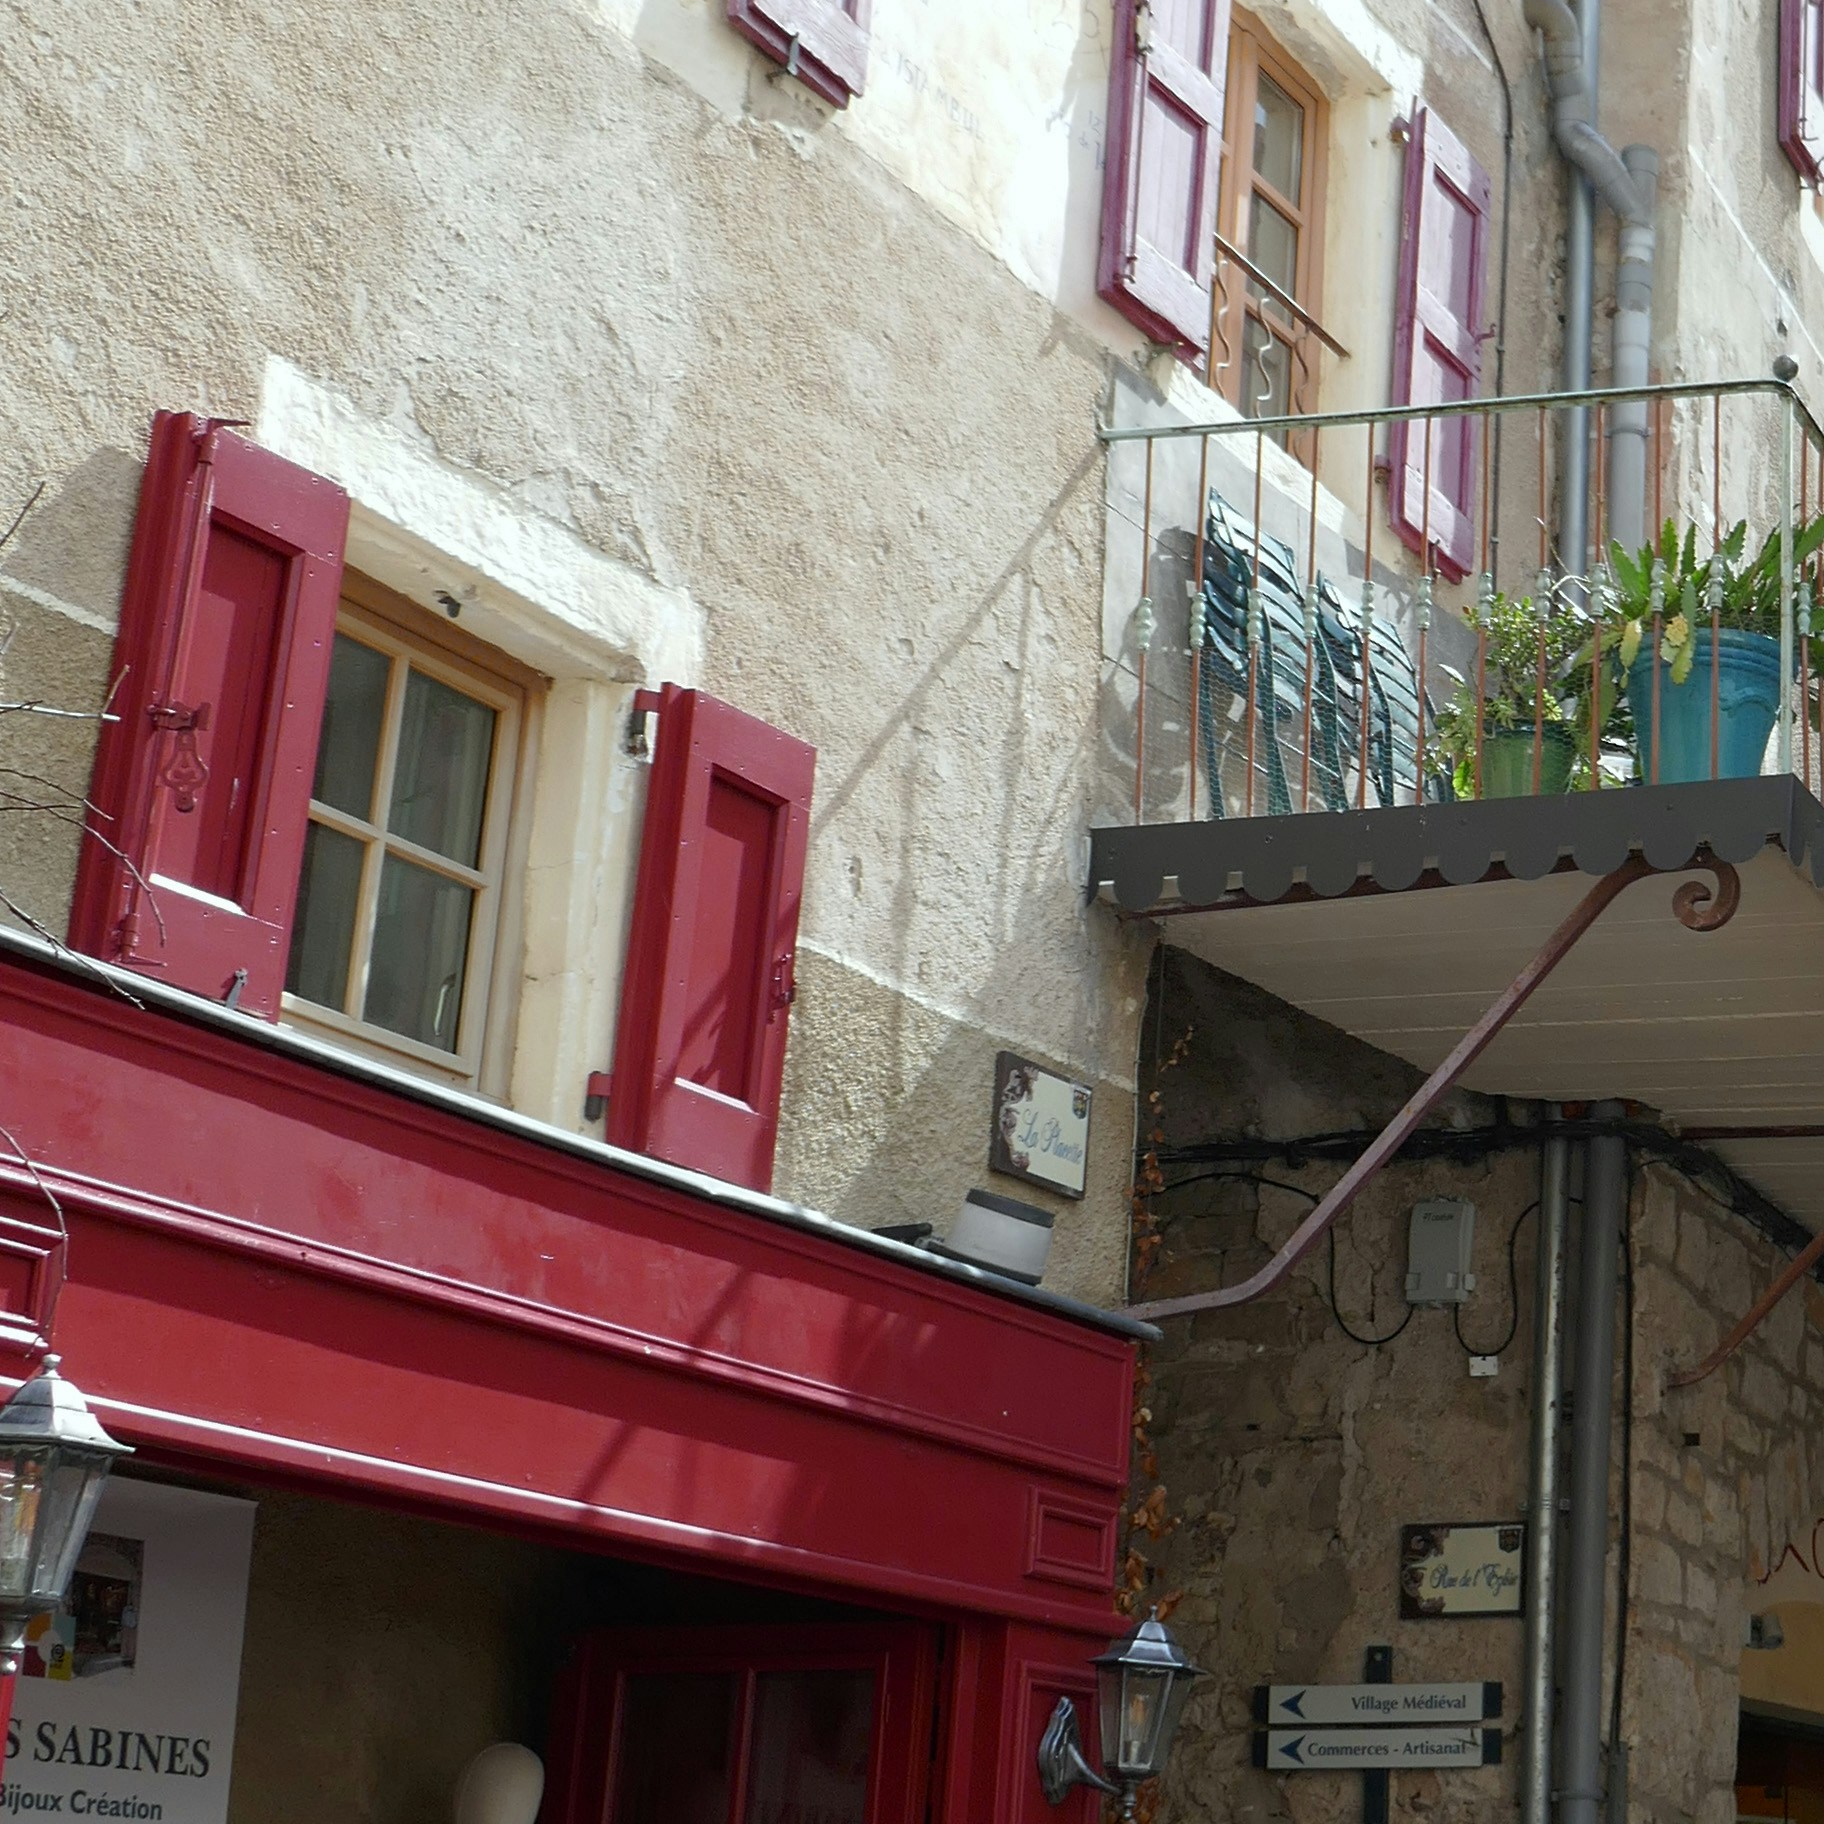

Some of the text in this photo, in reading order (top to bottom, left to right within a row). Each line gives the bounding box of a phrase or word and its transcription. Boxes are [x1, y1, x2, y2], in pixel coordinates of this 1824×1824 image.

[1351, 1694, 1467, 1714] Village Médiéval
[33, 1721, 211, 1778] SABINES
[1307, 1741, 1390, 1757] Commerces
[70, 1789, 163, 1821] Création
